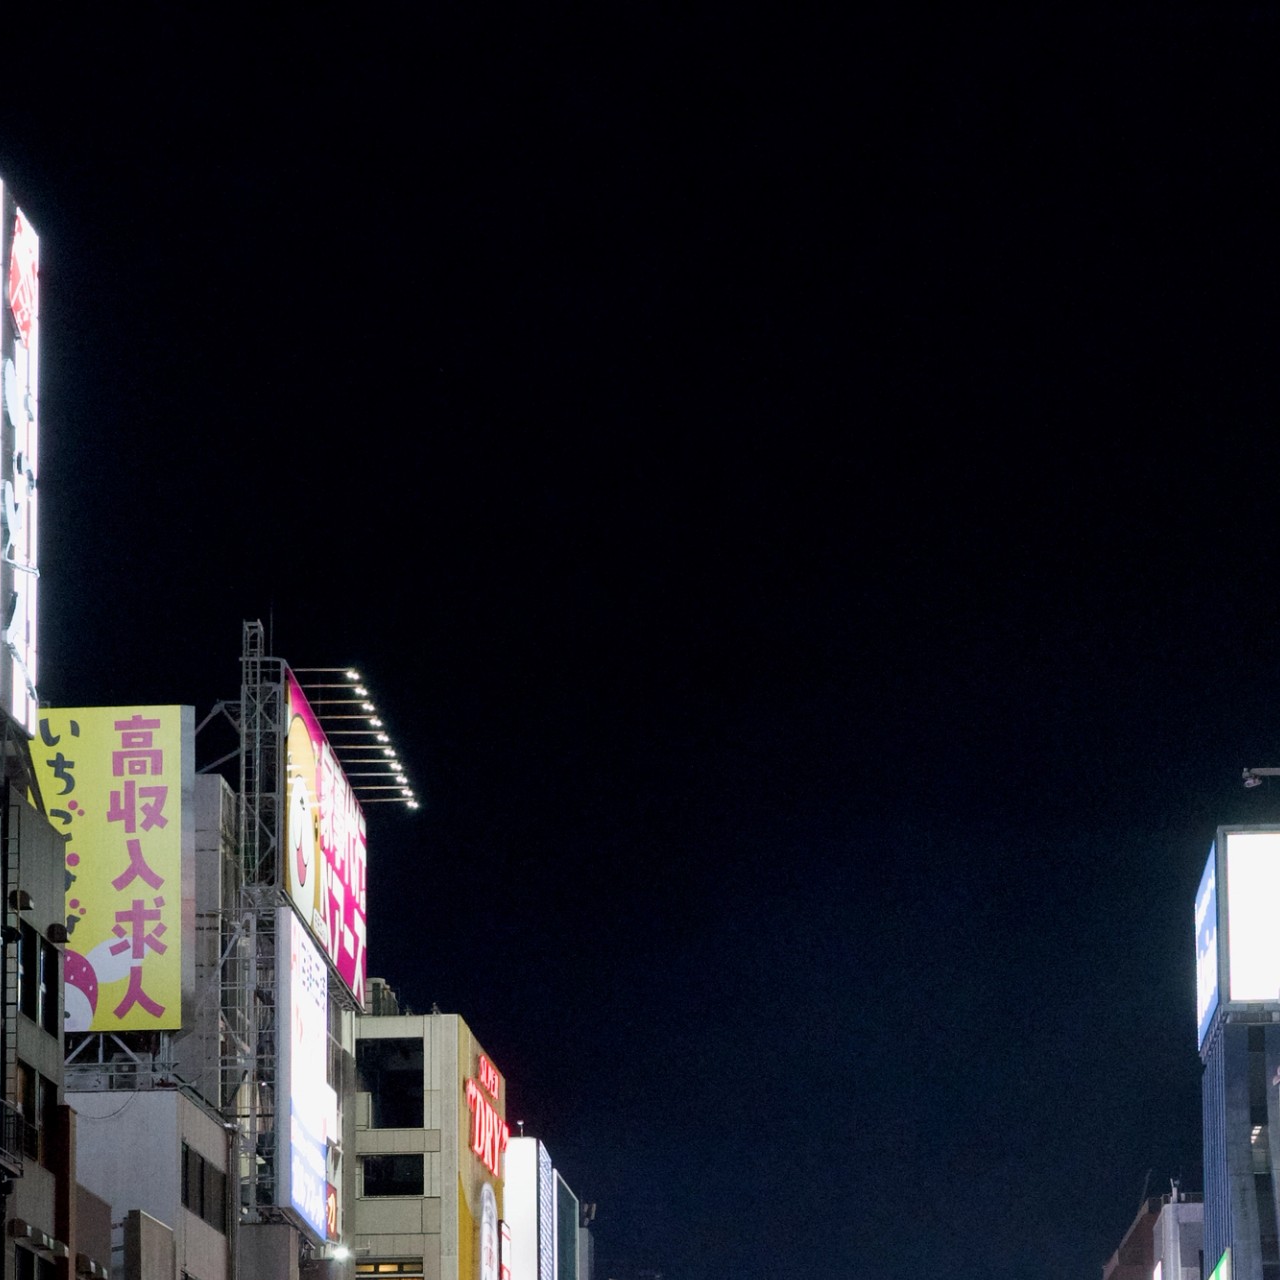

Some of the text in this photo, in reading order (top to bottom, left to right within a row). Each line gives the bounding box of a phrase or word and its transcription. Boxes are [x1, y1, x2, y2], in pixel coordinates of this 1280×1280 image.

[106, 714, 169, 1021] 高収入求人
